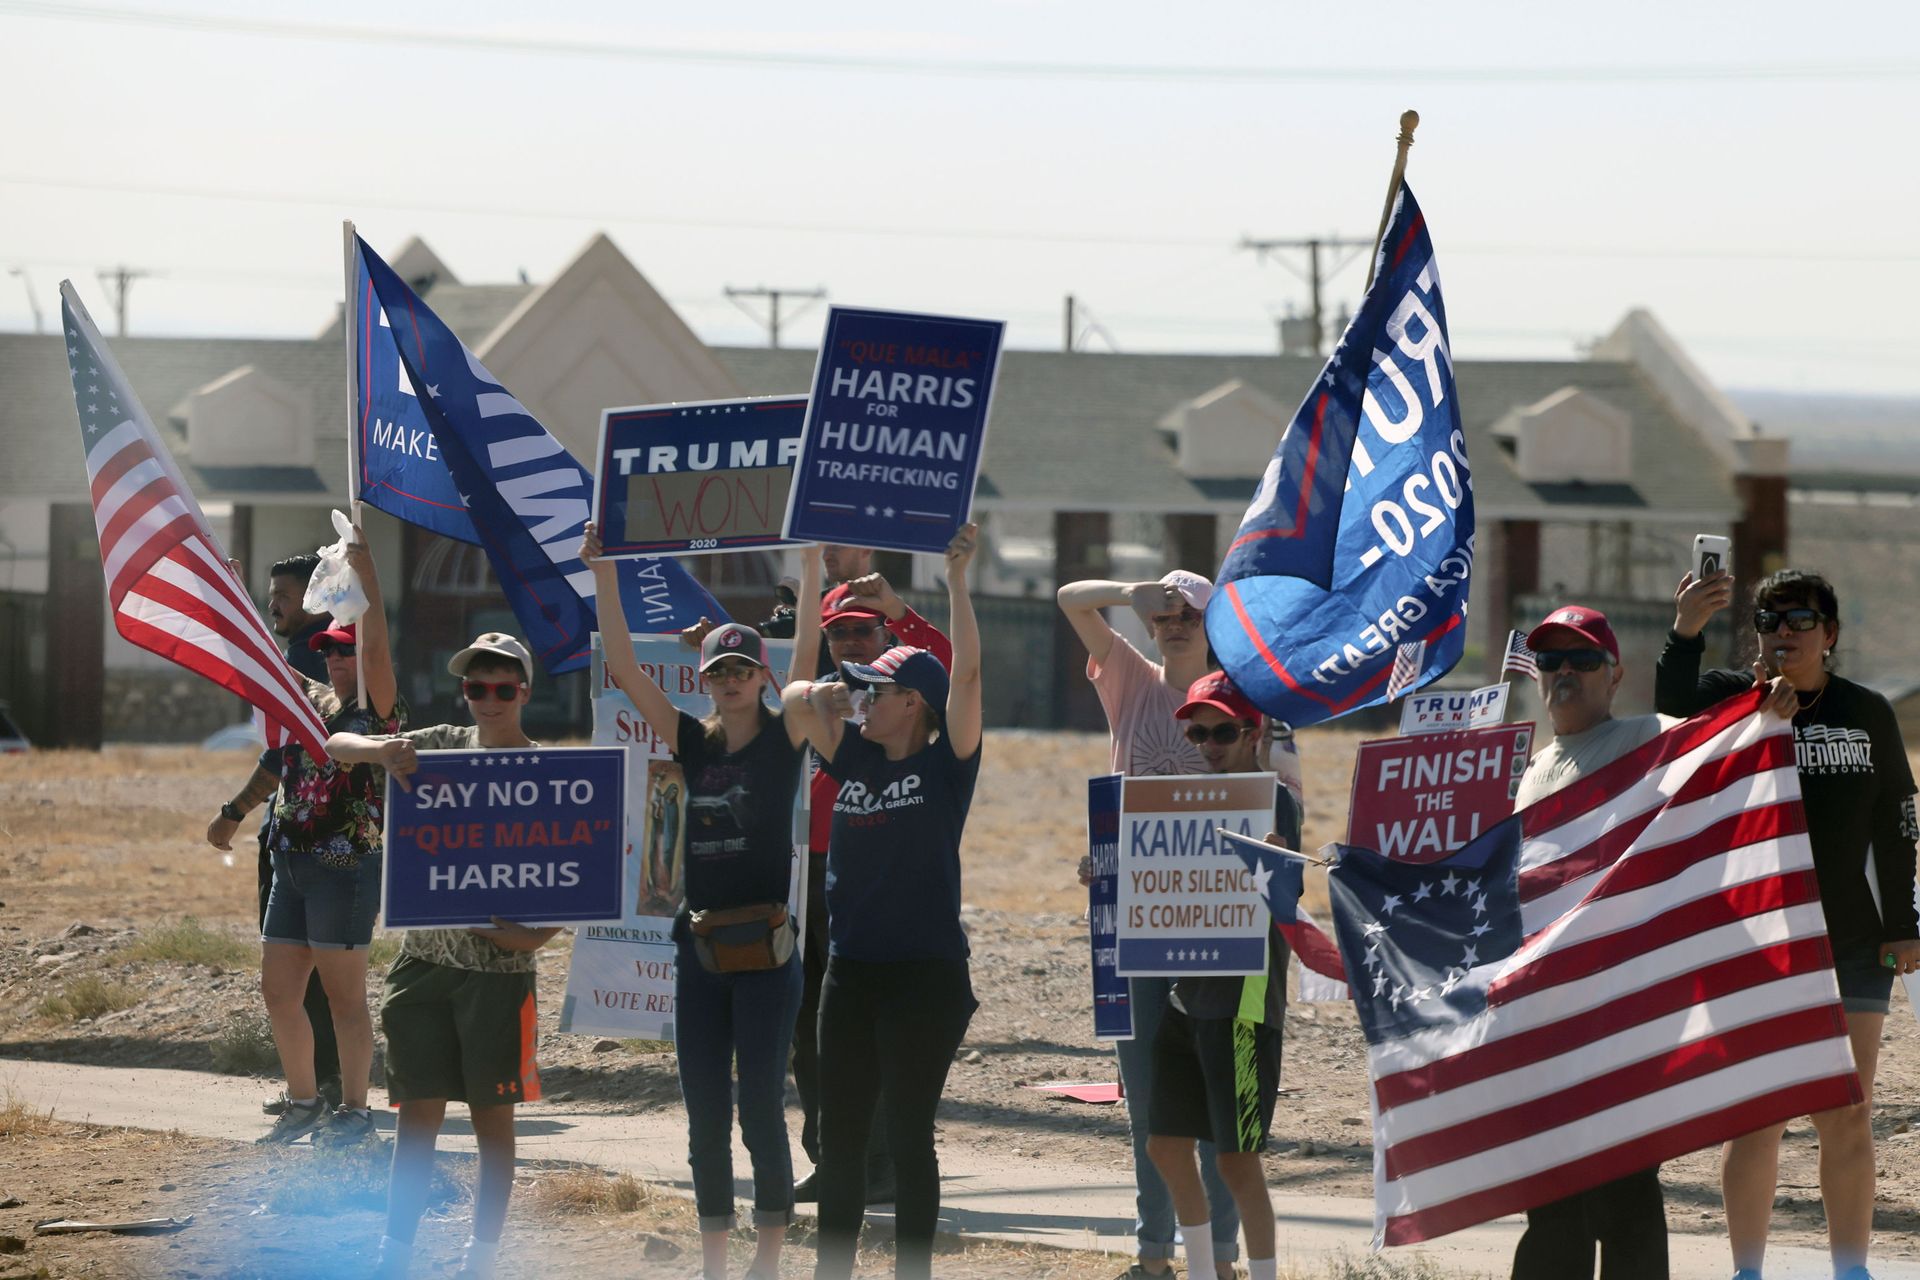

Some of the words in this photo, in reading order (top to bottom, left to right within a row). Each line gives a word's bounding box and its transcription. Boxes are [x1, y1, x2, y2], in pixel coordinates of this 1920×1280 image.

[830, 367, 976, 409] HARRIS
[866, 402, 899, 418] FOR
[373, 418, 439, 462] MAKE
[820, 421, 967, 462] HUMAN
[816, 460, 960, 490] TRAFFICKING
[652, 473, 770, 536] WON
[689, 538, 718, 550] 2020
[1414, 690, 1499, 714] TRUMP
[1418, 706, 1489, 723] PENCE
[1377, 745, 1503, 792] FINISH
[1797, 764, 1860, 775] ACKSON
[416, 783, 478, 810] SAY
[488, 781, 539, 806] NO
[549, 779, 594, 805] TO
[885, 796, 925, 809] GREAT!
[1415, 790, 1455, 813] THE
[1092, 842, 1119, 877] HARRI
[429, 862, 580, 891] HARRIS
[1131, 870, 1183, 894] YOUR
[1128, 905, 1145, 929] IS
[1150, 904, 1257, 928] COMPLICITY
[587, 926, 663, 942] DEMOCRATS
[635, 960, 674, 980] VOT
[593, 989, 641, 1011] VOTE
